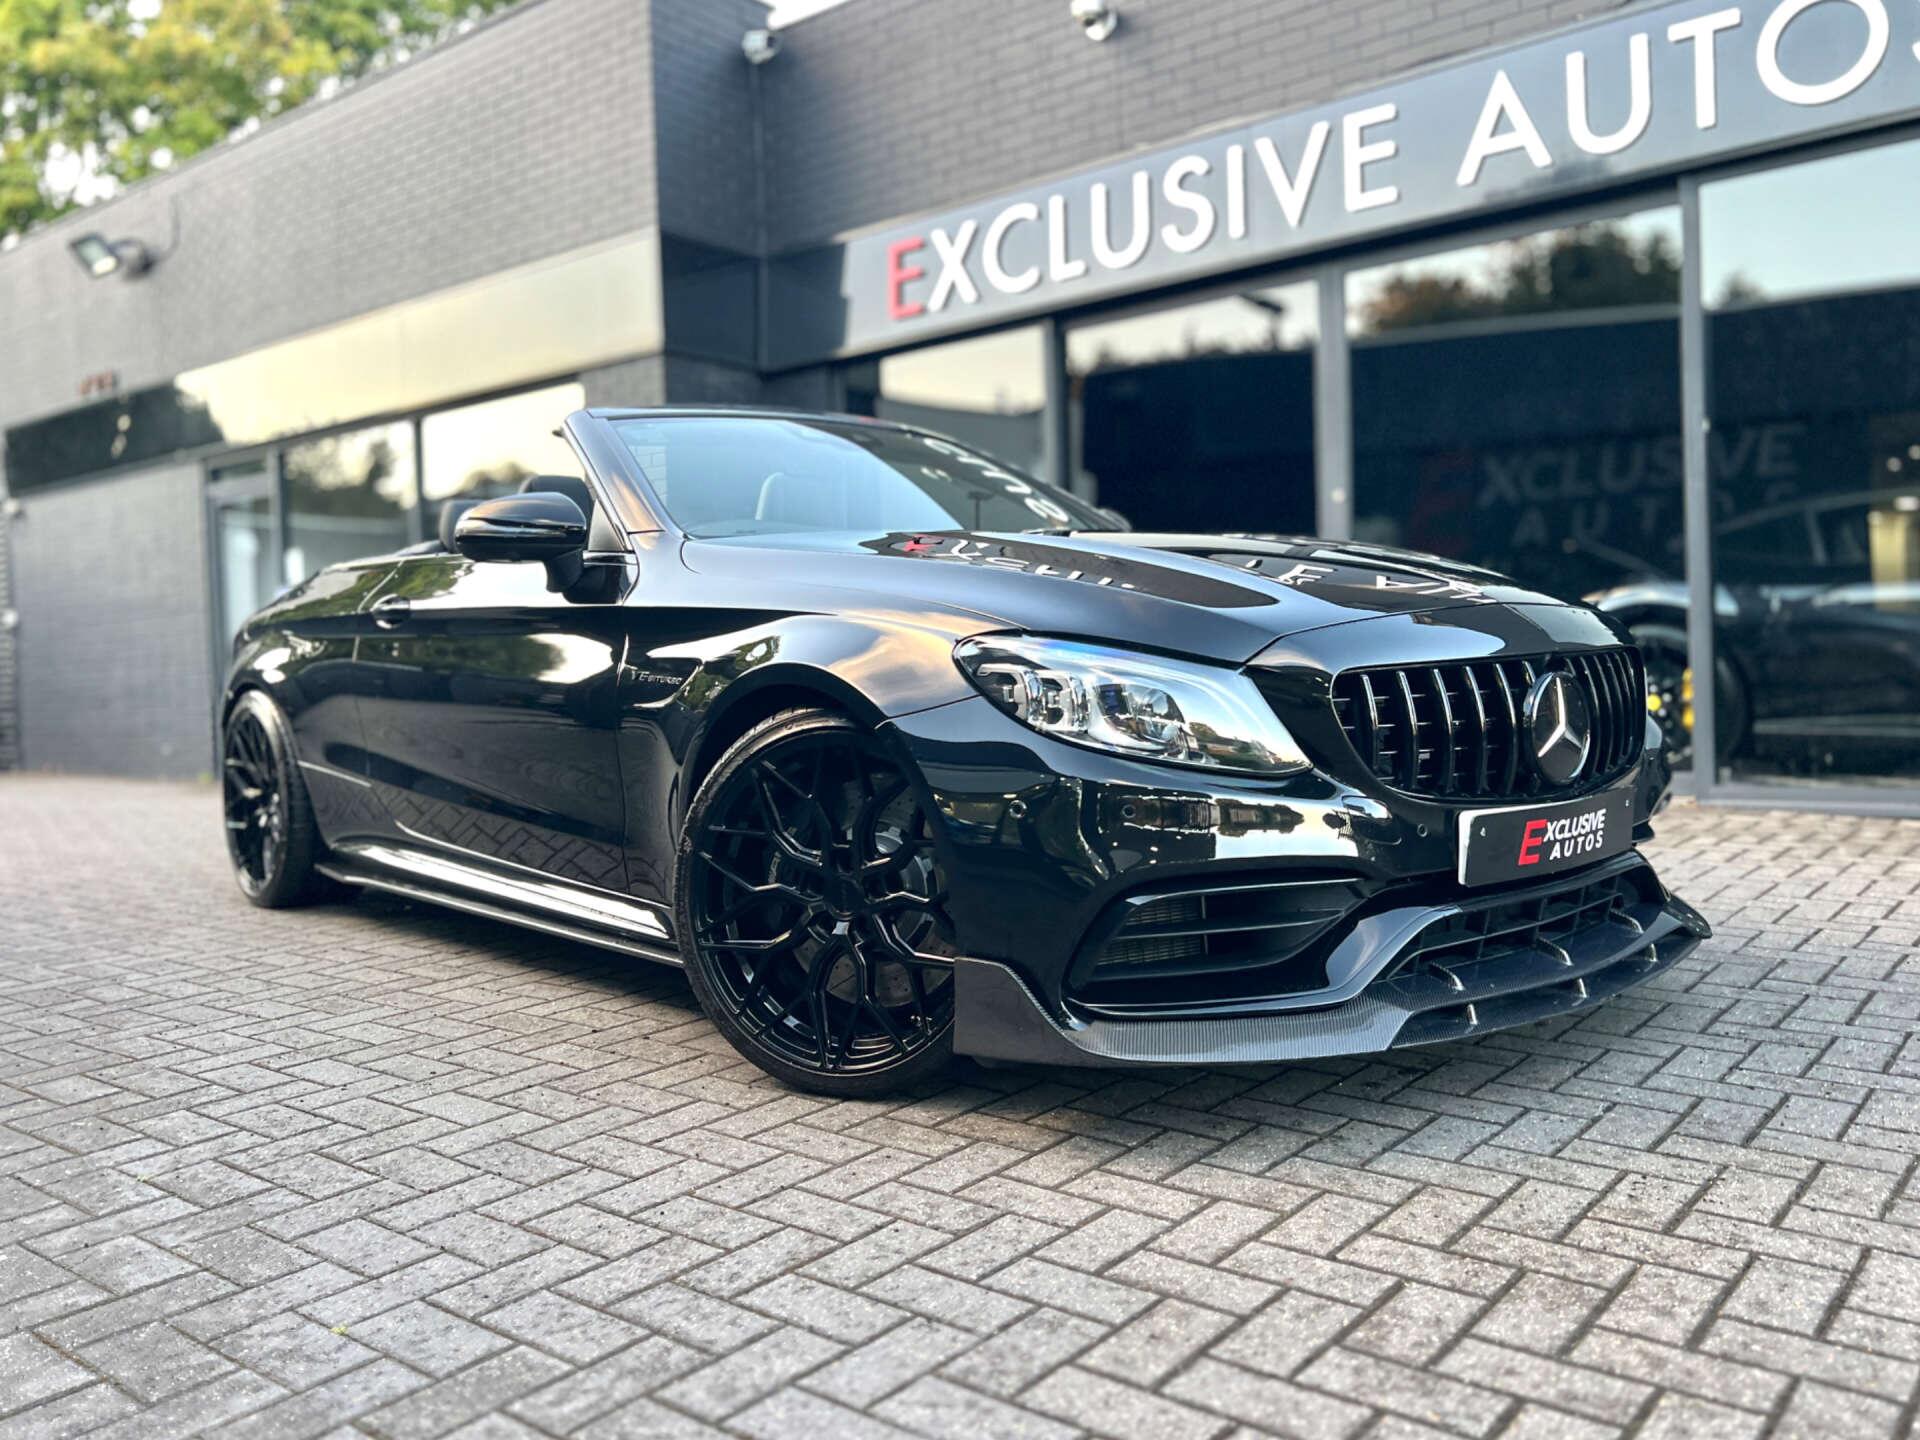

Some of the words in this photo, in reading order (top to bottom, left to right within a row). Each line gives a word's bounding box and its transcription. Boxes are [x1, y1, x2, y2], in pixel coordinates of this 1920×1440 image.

[887, 102, 1400, 320] EXCLUSIVE
[1456, 0, 1920, 187] AUTO
[1411, 421, 1806, 555] EXCLUSVE
[1518, 808, 1607, 866] EXCLUSIVE
[1549, 831, 1604, 861] AUTOS
